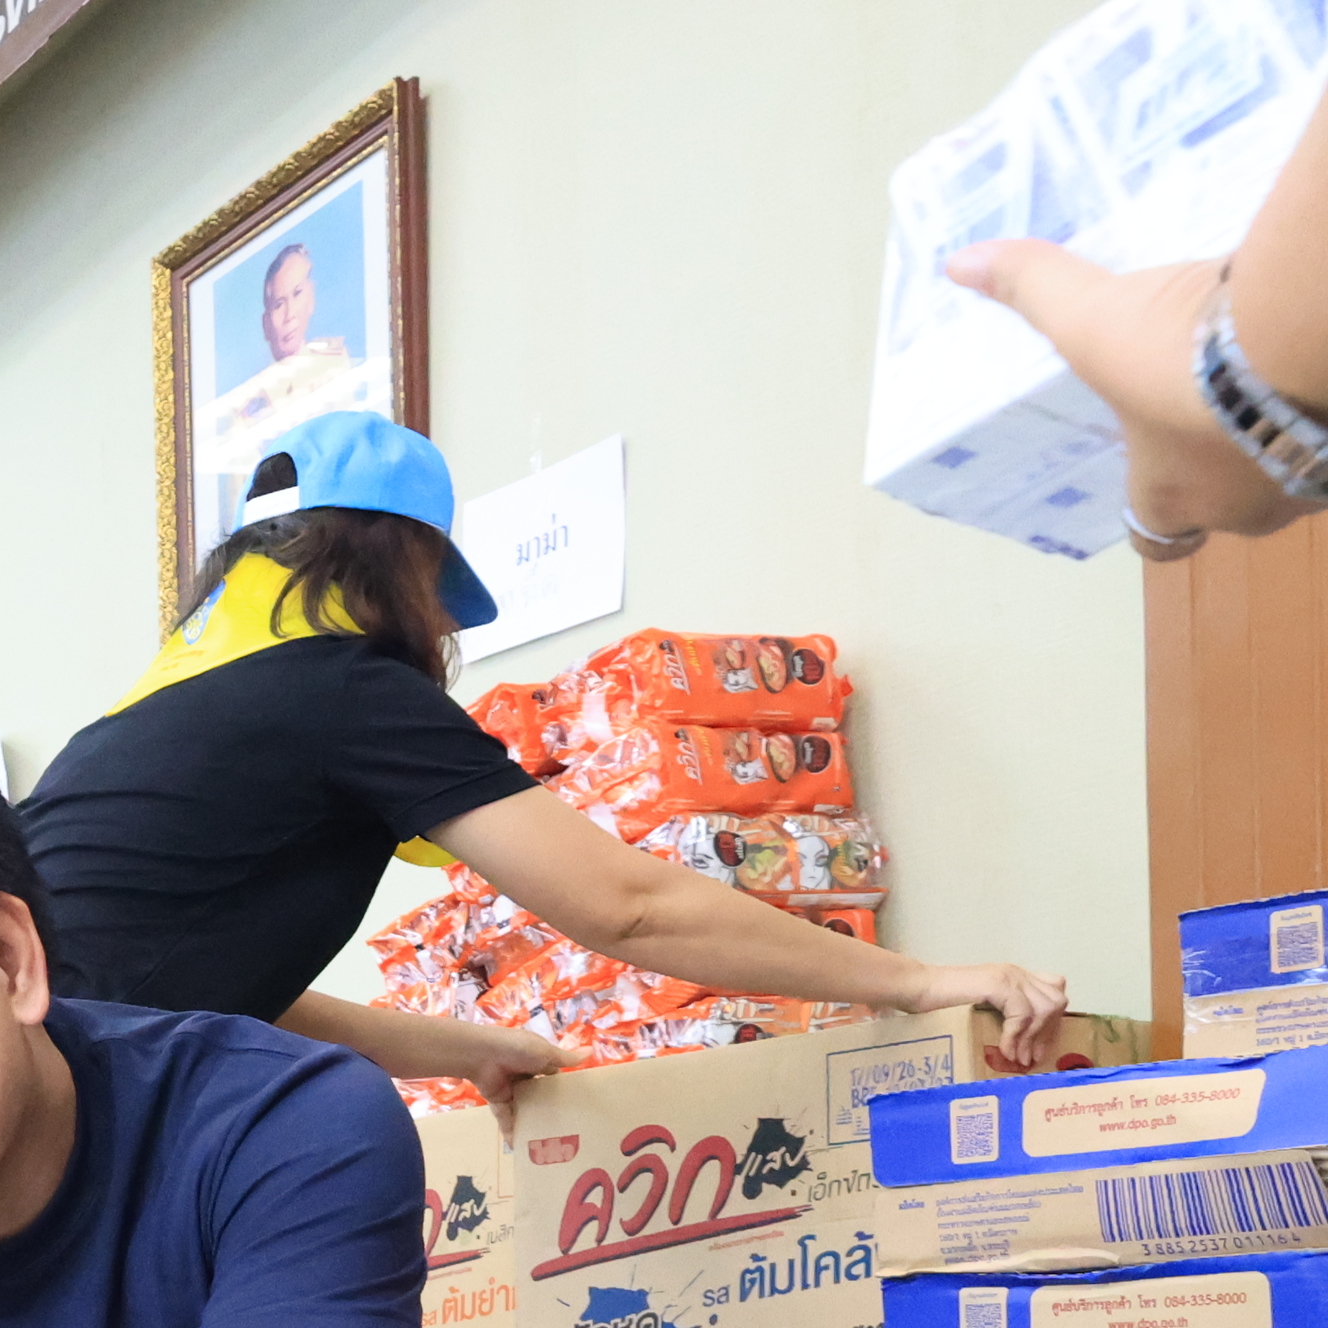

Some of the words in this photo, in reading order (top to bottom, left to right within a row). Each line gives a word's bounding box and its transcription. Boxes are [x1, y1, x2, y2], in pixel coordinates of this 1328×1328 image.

[516, 513, 569, 567] มาม่า
[1154, 1087, 1242, 1108] 084-335-8000
[1099, 1114, 1177, 1134] www.dpo.go.th
[557, 1123, 737, 1256] ควิก
[702, 1283, 731, 1307] รส
[739, 1231, 879, 1303] ต้มโคล้
[441, 1276, 518, 1326] ต้มยำ
[1164, 1291, 1247, 1309] 084-335-8000
